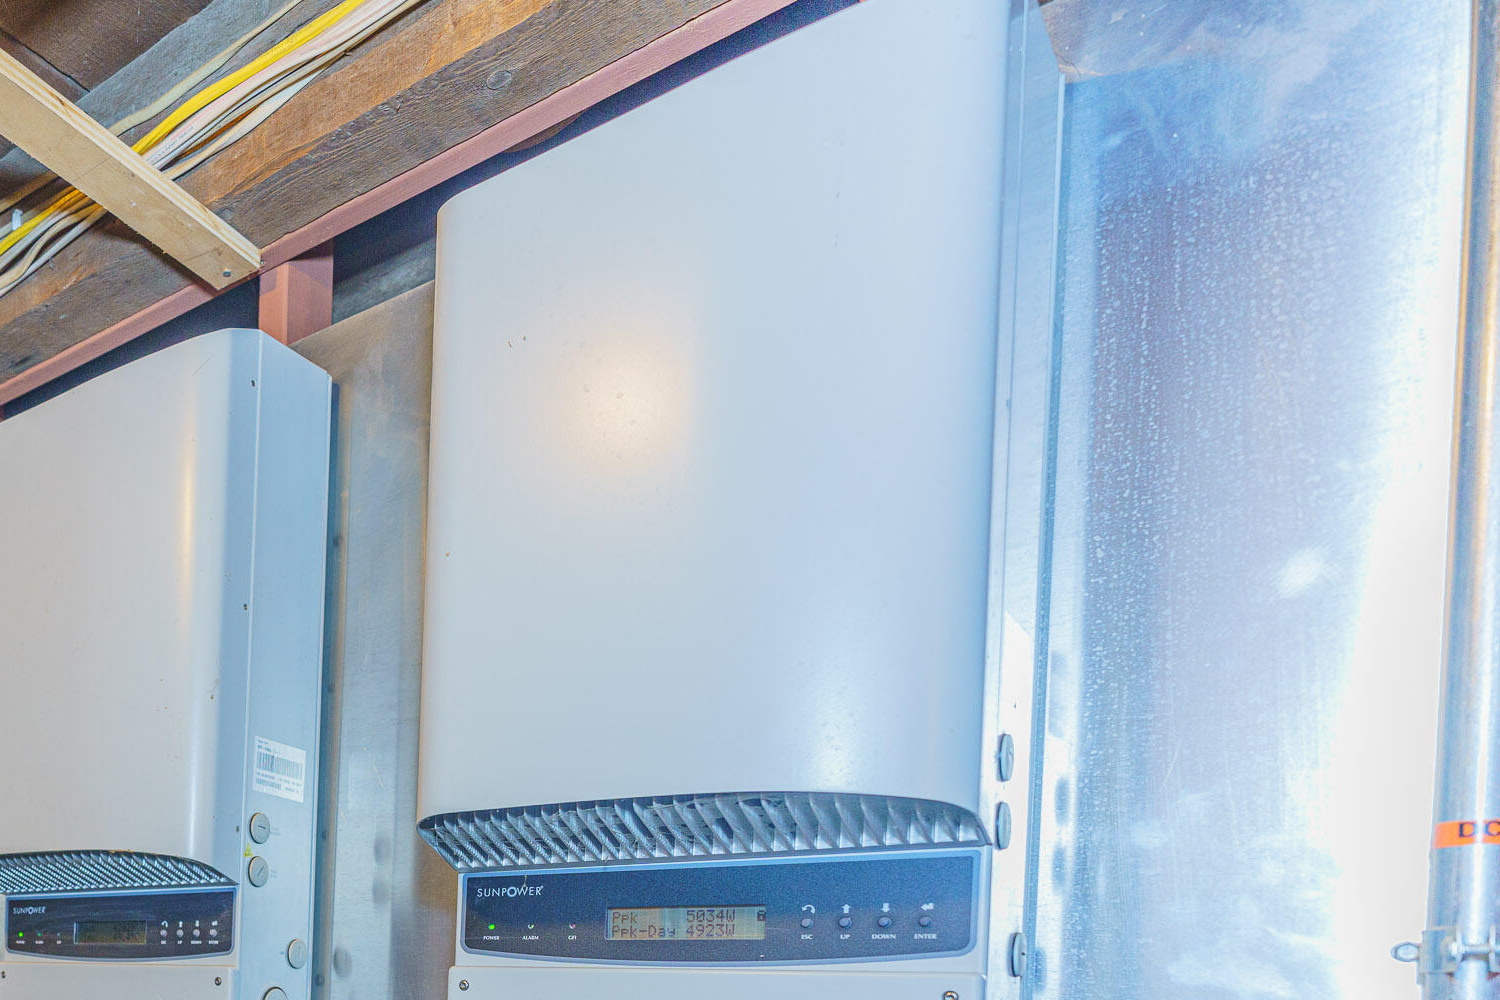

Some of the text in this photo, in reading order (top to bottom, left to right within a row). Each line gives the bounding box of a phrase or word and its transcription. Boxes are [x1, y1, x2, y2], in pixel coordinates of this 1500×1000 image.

[477, 886, 543, 898] SUNPOWER
[686, 909, 735, 923] 5034W
[686, 924, 735, 937] 4923W
